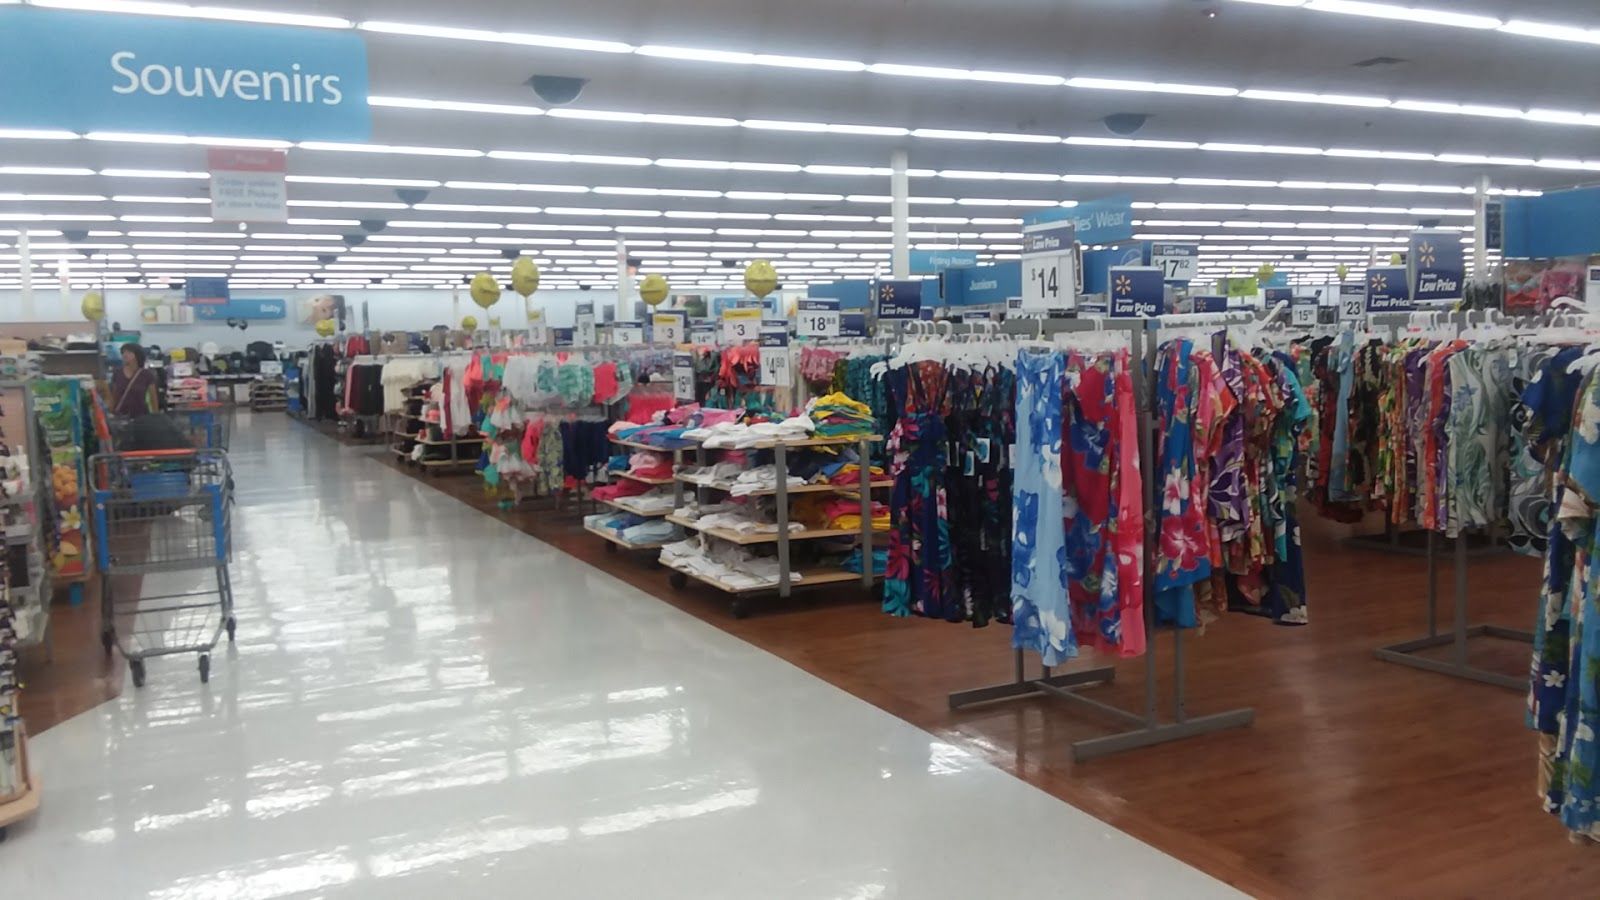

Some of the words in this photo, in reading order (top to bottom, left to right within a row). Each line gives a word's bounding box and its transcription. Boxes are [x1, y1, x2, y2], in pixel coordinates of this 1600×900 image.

[111, 51, 342, 105] Souvenirs
[1096, 211, 1125, 228] Wear
[1033, 239, 1045, 249] Low
[1045, 236, 1060, 248] Price
[969, 279, 998, 291] Juniors
[1031, 266, 1058, 298] $14
[1419, 279, 1436, 292] Low
[1437, 278, 1457, 291] Price
[1115, 302, 1134, 312] Low
[1135, 302, 1157, 312] Price
[1371, 297, 1389, 307] Low
[260, 304, 281, 314] Baby
[880, 307, 896, 315] Low
[896, 307, 915, 315] Price
